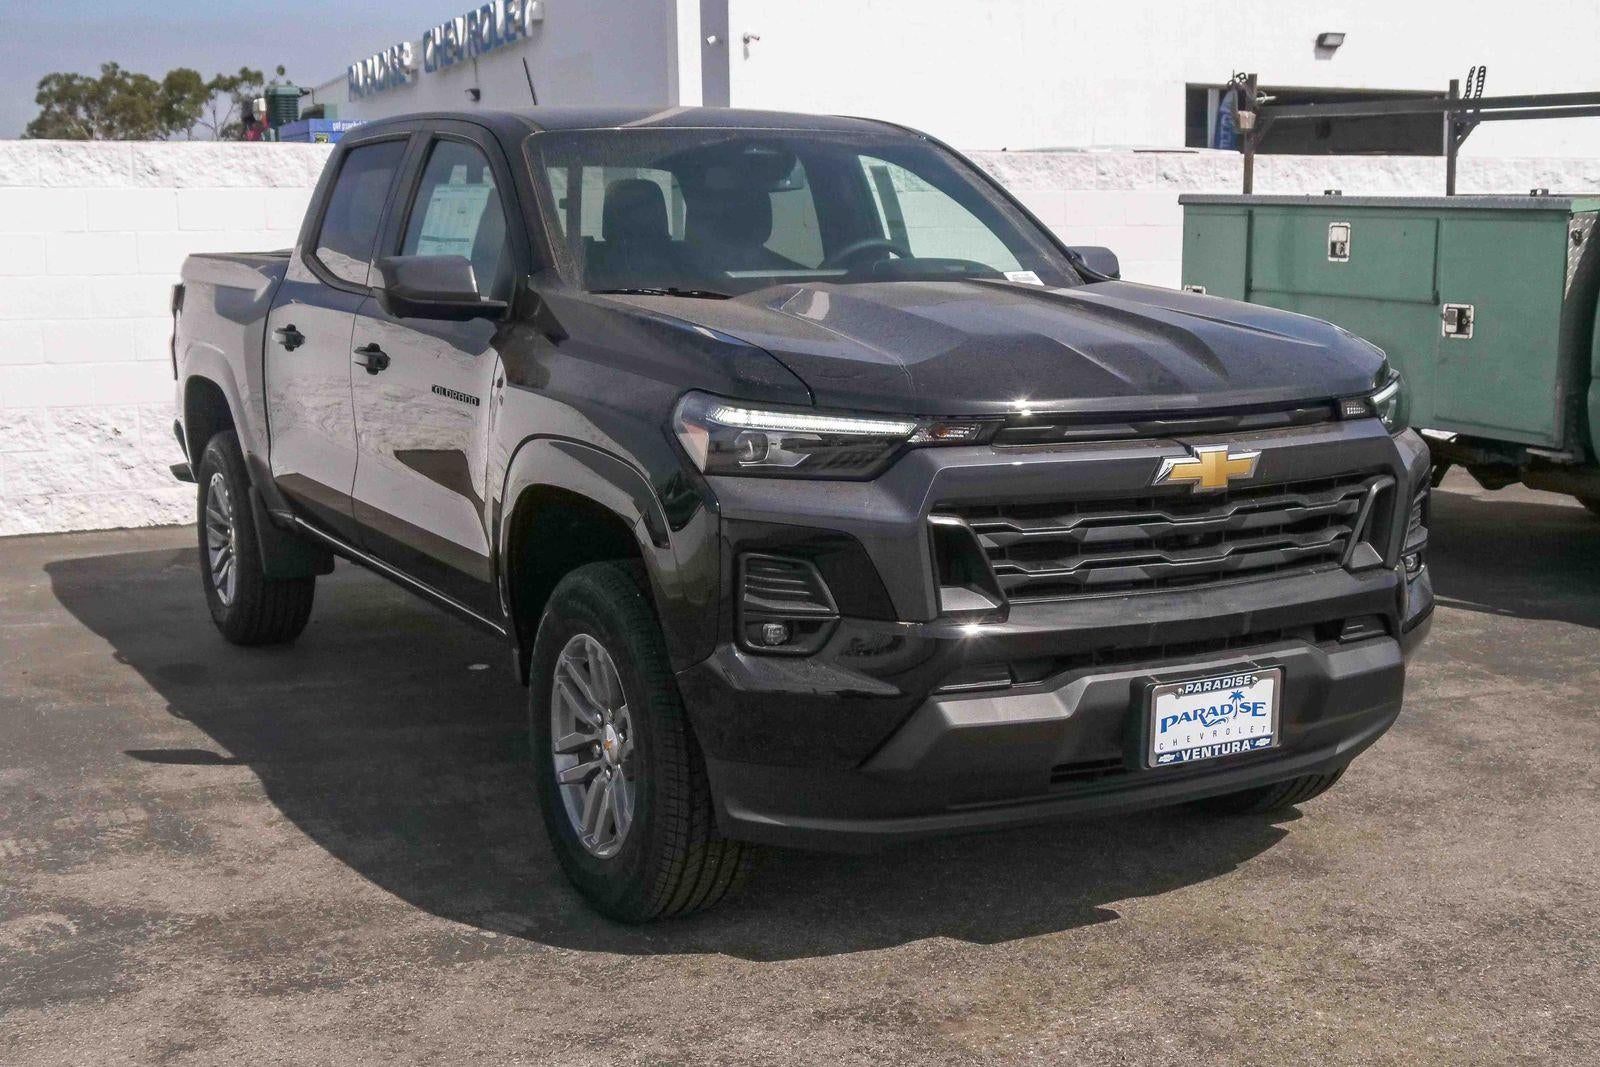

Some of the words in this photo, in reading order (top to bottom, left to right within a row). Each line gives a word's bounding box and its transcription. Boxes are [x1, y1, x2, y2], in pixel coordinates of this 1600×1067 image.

[423, 0, 543, 73] CHEVROLET
[1184, 674, 1252, 694] PARADISE
[1160, 690, 1267, 734] PARADISE
[1159, 725, 1267, 751] CHEVROLET
[1181, 739, 1251, 761] VENTURA
